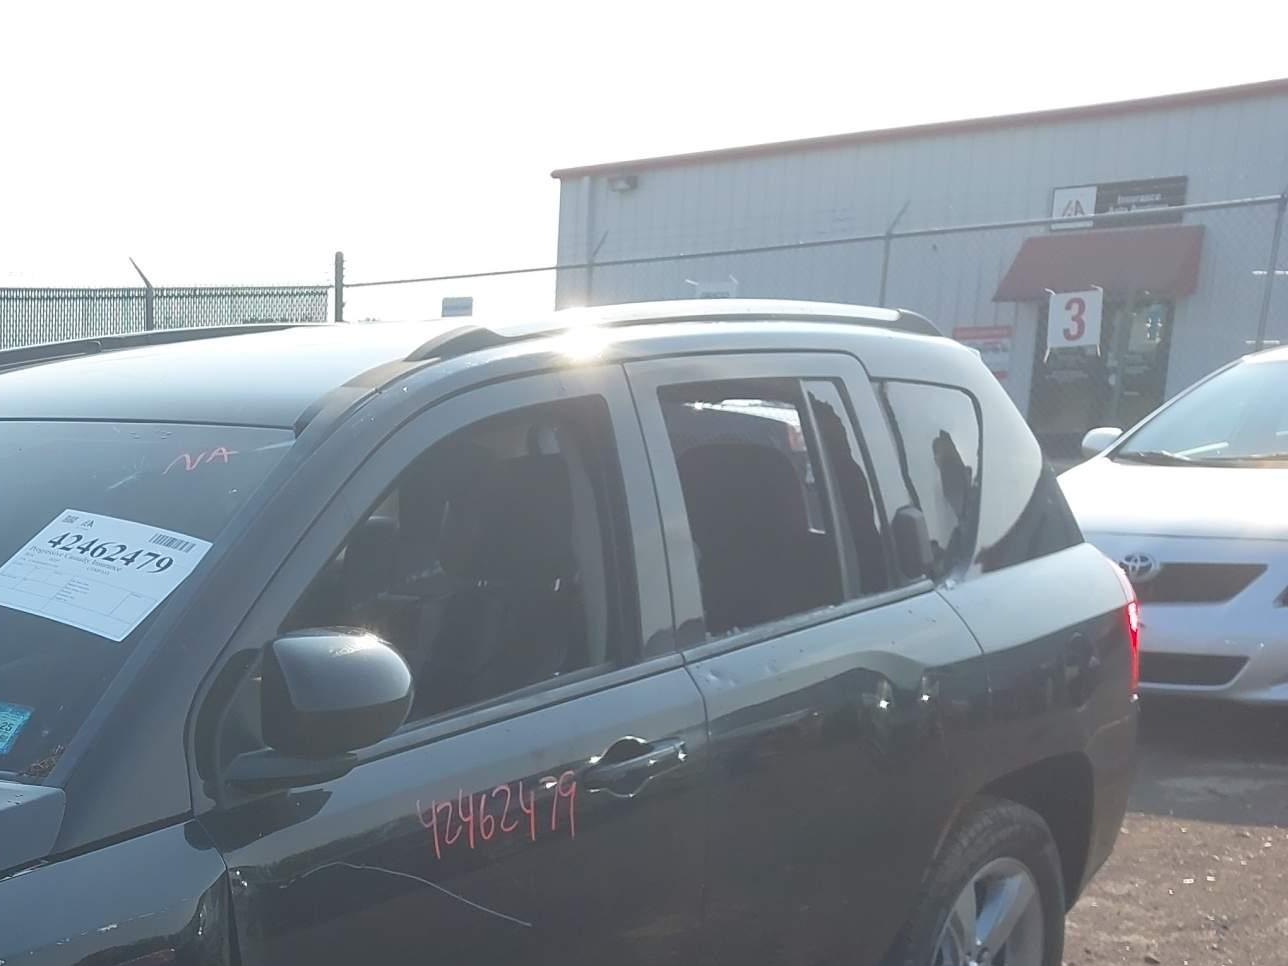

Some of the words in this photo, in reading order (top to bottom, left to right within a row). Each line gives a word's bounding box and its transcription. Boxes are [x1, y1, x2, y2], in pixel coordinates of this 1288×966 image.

[1063, 297, 1086, 341] 3
[48, 532, 174, 574] 42462479
[416, 770, 577, 860] 42462479
